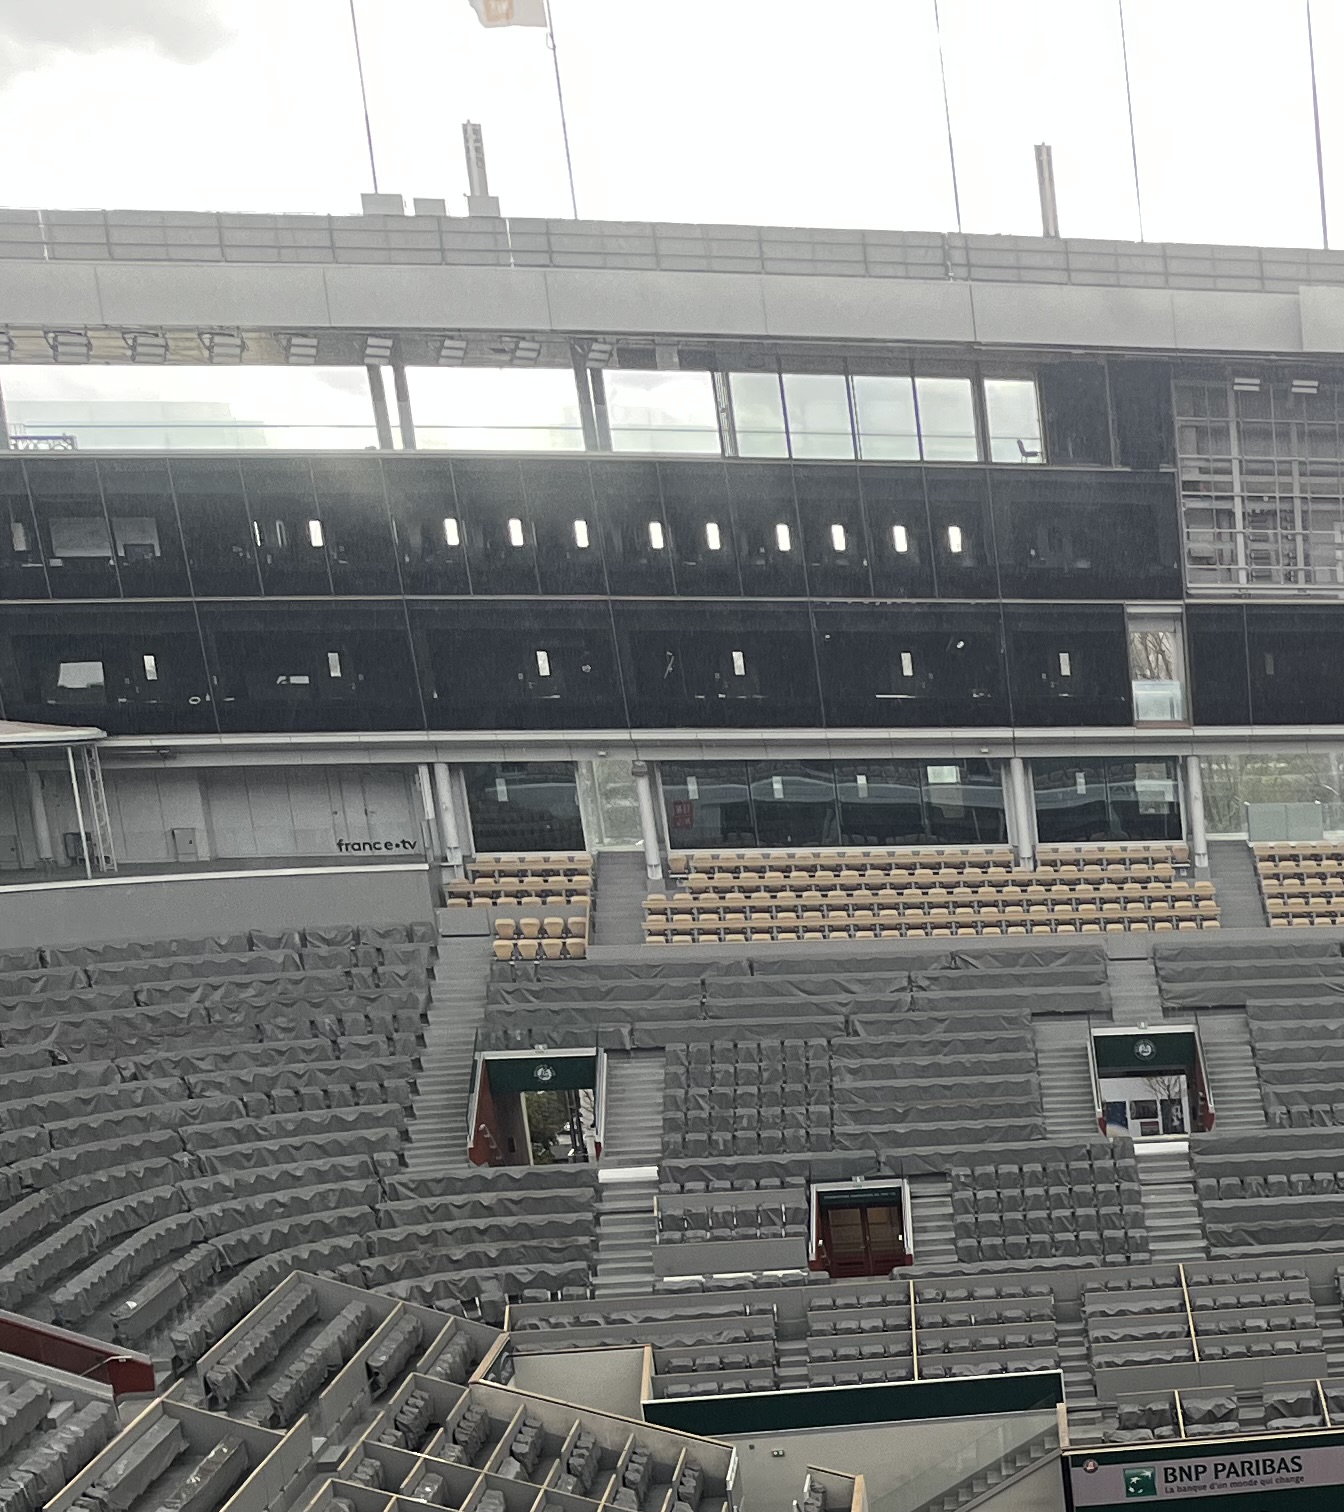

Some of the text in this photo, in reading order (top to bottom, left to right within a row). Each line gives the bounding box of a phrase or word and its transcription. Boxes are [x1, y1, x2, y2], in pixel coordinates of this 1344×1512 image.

[1163, 1455, 1303, 1484] BNP PARIBAS
[1165, 1475, 1304, 1494] La banque d'un monde qui change
